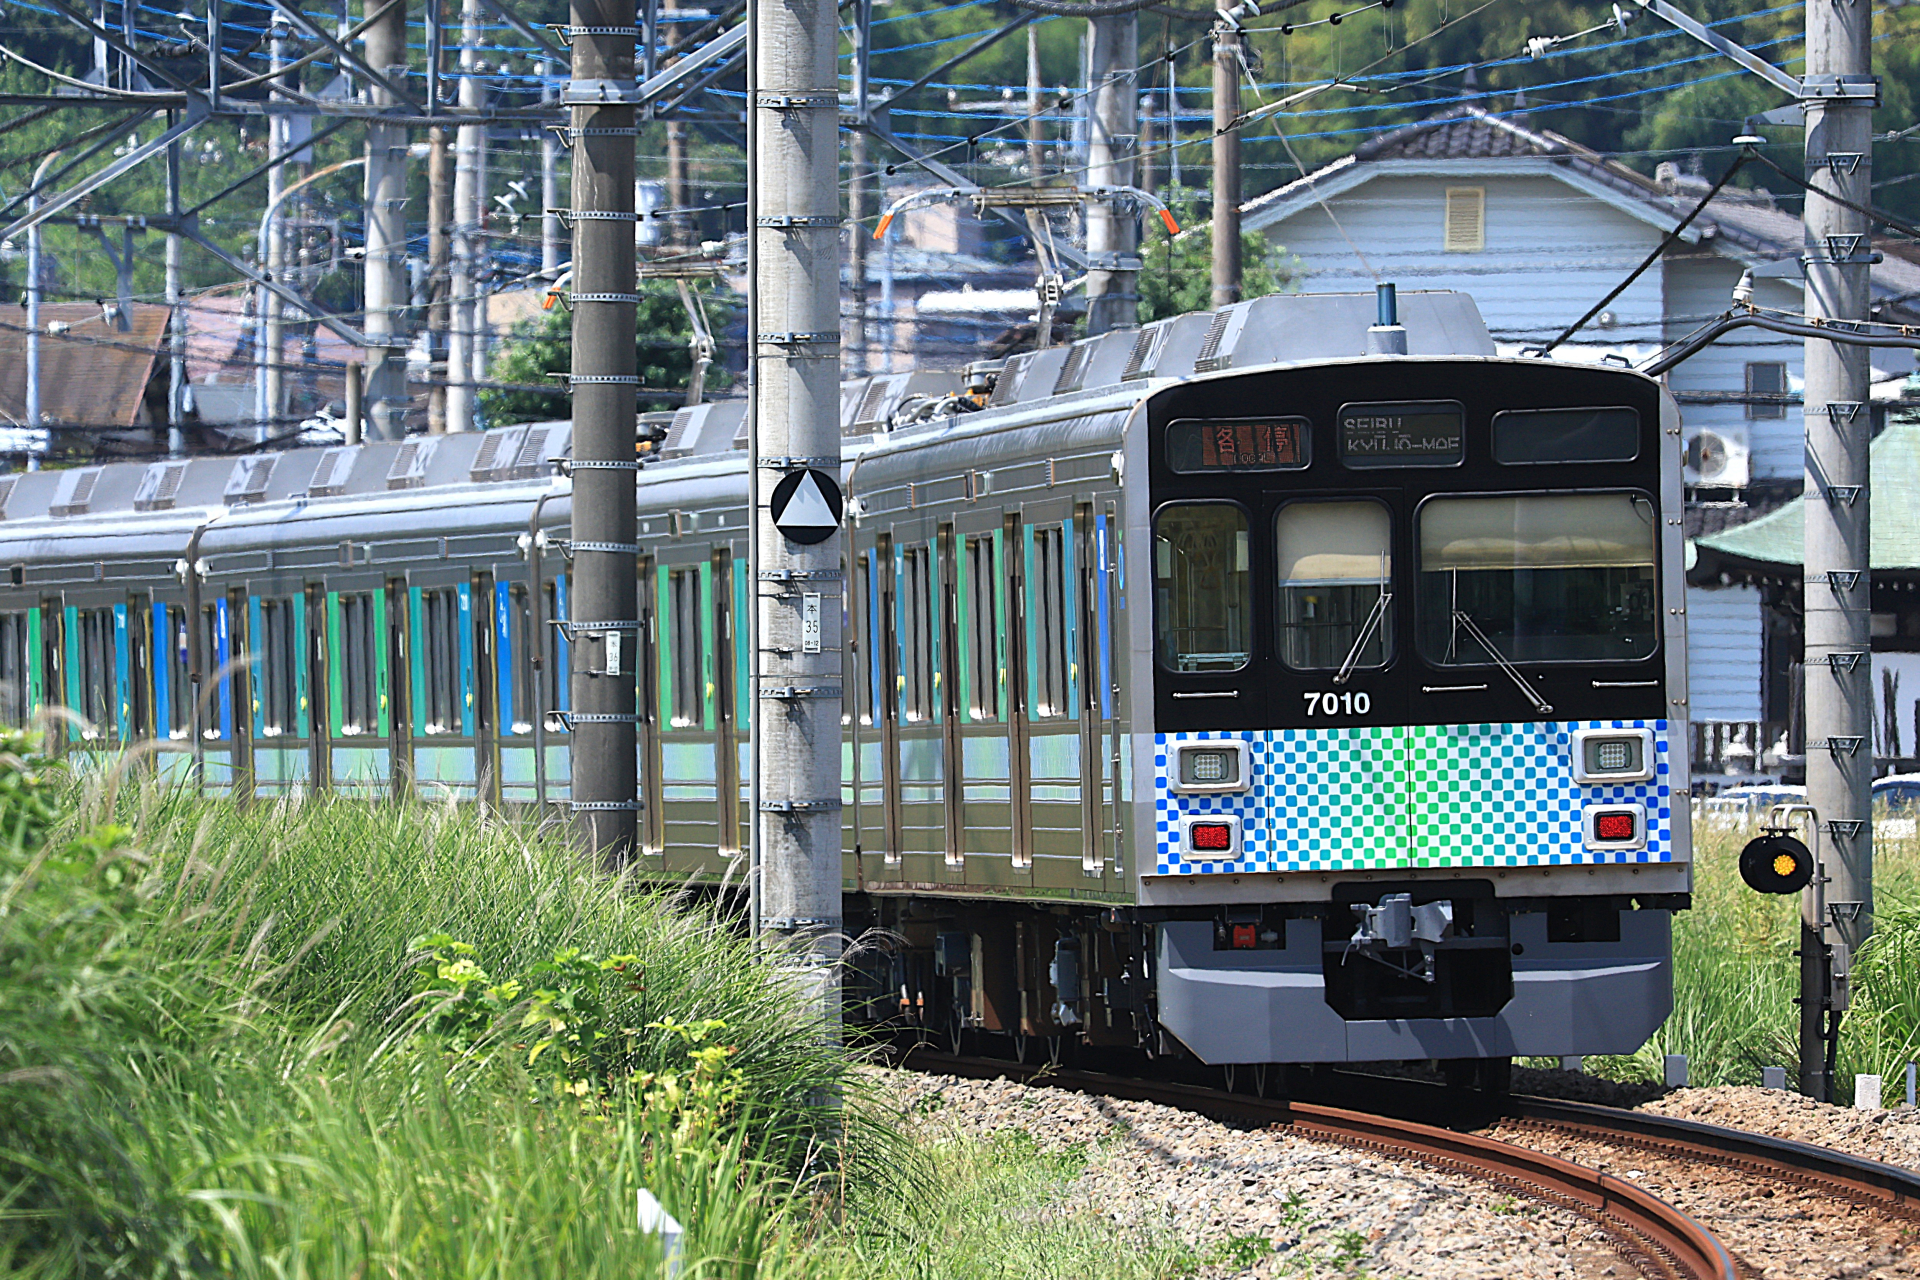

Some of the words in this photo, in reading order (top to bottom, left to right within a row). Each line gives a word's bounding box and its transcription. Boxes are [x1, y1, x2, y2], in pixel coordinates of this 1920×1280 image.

[1216, 426, 1289, 453] 各停
[805, 620, 819, 634] 35
[608, 652, 618, 662] 36
[1303, 691, 1371, 716] 7010
